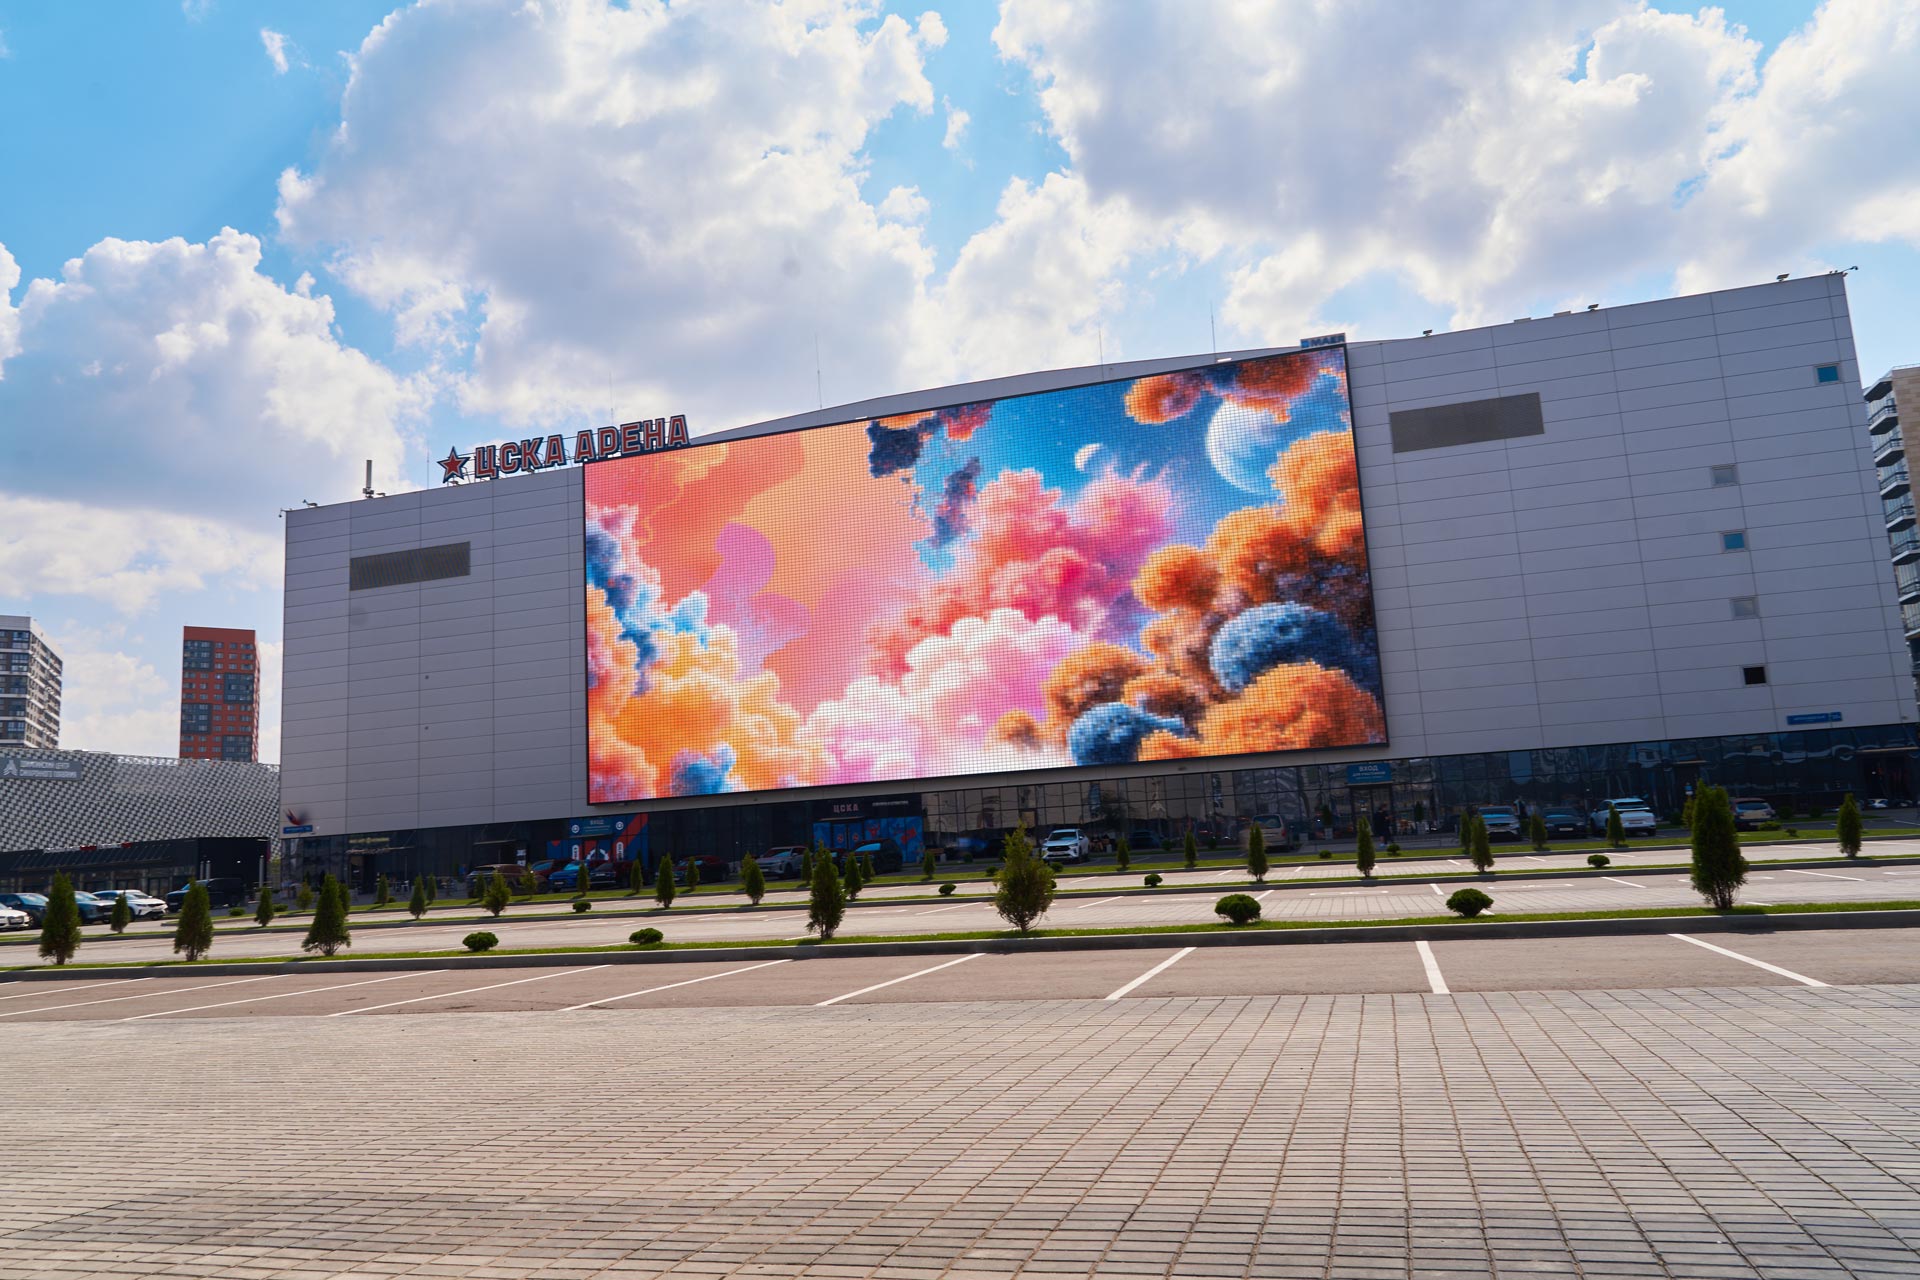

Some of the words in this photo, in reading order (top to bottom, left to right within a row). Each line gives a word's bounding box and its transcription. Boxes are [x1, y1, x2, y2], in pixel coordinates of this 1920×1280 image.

[475, 434, 567, 480] ЦСКА
[574, 414, 690, 463] АРЕНА
[833, 803, 859, 813] ЦСКА
